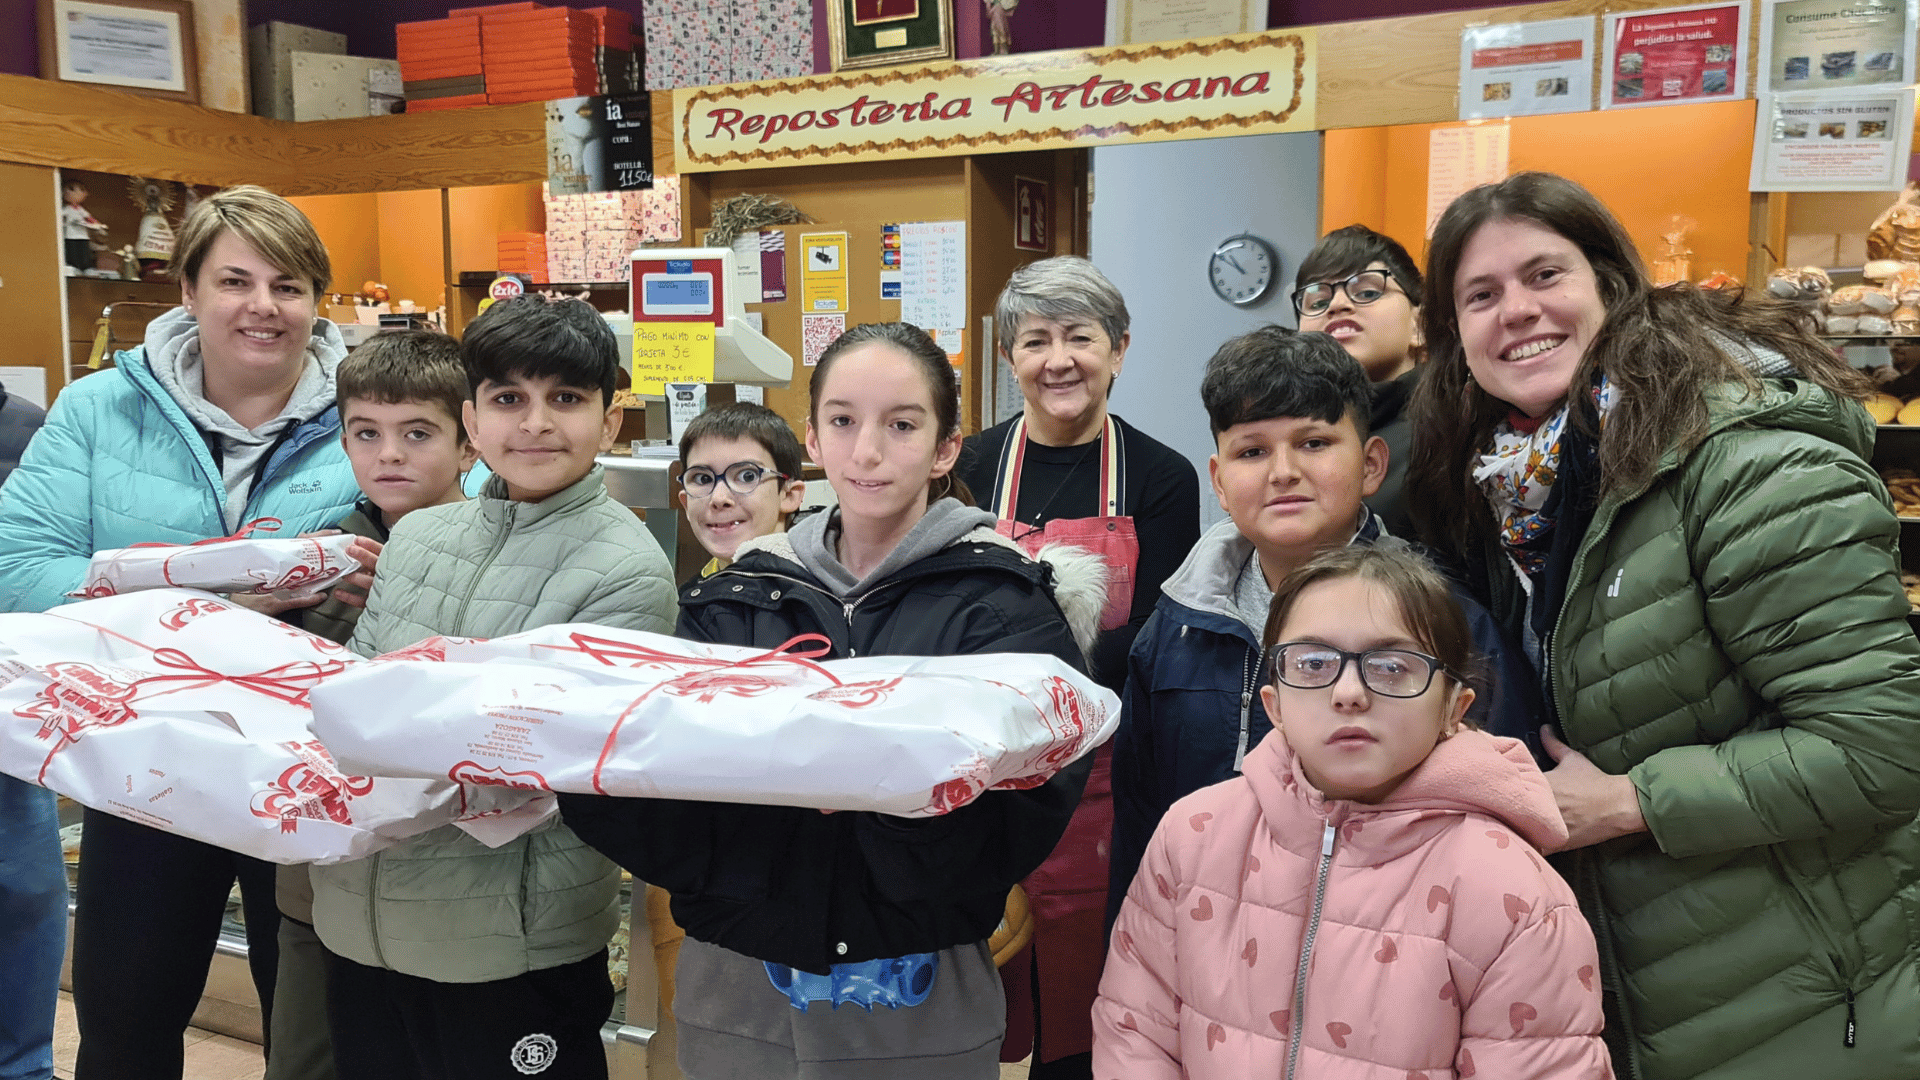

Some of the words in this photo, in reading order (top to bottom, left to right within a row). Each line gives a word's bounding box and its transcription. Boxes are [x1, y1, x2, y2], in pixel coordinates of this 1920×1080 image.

[1786, 11, 1837, 24] Consume
[1634, 34, 1675, 47] perjudica
[991, 70, 1272, 124] Artesana
[1780, 107, 1834, 116] PRODUCTOS
[1836, 106, 1853, 115] SIN
[634, 327, 657, 341] PAGO
[695, 333, 709, 341] CON
[288, 486, 322, 495] Wolfskin
[495, 723, 531, 734] ZARAGOZA
[148, 787, 173, 804] Galletas
